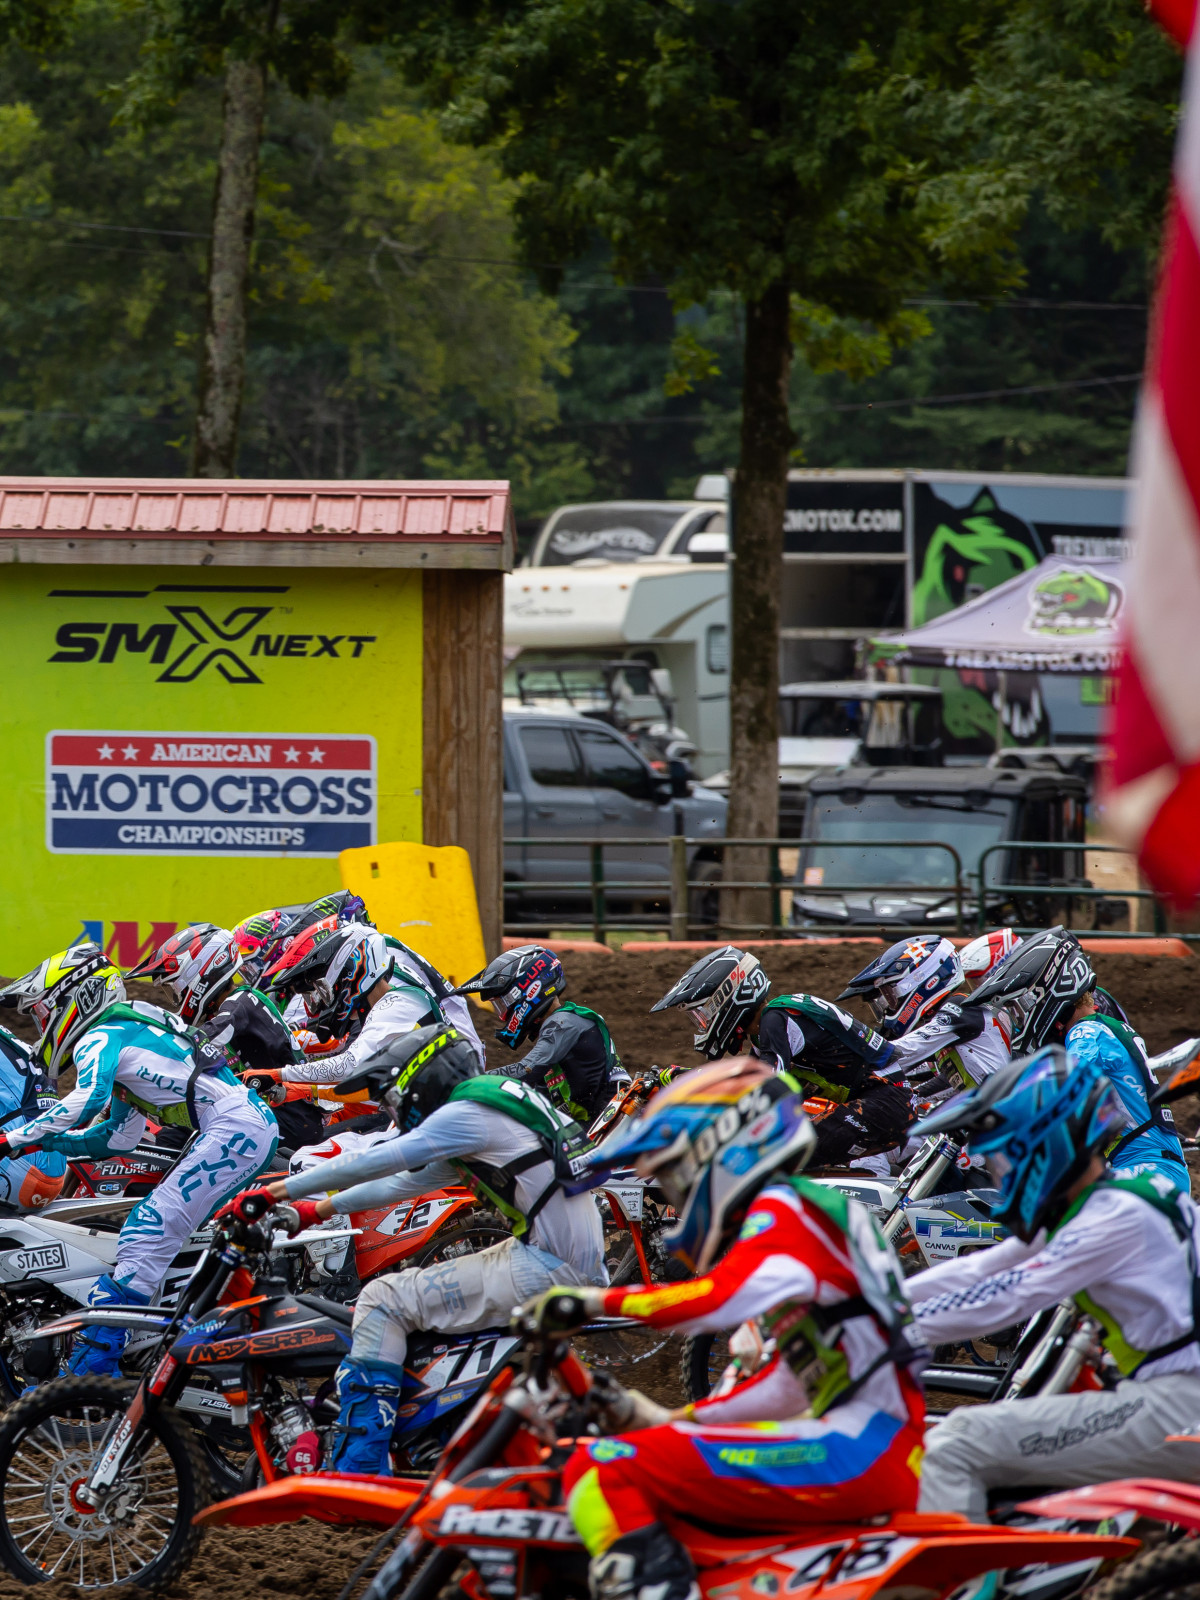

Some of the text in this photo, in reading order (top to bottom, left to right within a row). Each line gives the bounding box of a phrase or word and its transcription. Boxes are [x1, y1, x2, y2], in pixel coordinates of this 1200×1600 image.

[783, 509, 902, 533] MOTOX.COM
[250, 634, 377, 658] NEXT
[151, 743, 272, 763] AMERICAN
[51, 772, 373, 816] MOTOCROSS
[118, 825, 305, 845] CHAMPIONSHIPS
[214, 953, 227, 966] BELL
[48, 955, 108, 1002] SCOTT
[927, 978, 939, 989] BELL
[527, 983, 540, 999] BELL
[898, 992, 924, 1025] BROWN
[396, 1029, 458, 1092] SCOTT
[101, 1162, 149, 1176] FUTURE
[393, 1203, 431, 1234] 32
[925, 1241, 956, 1251] CANVAS
[17, 1248, 61, 1269] STATES
[102, 1419, 132, 1474] DUNLOP
[295, 1452, 311, 1463] 66
[787, 1535, 896, 1589] 48
